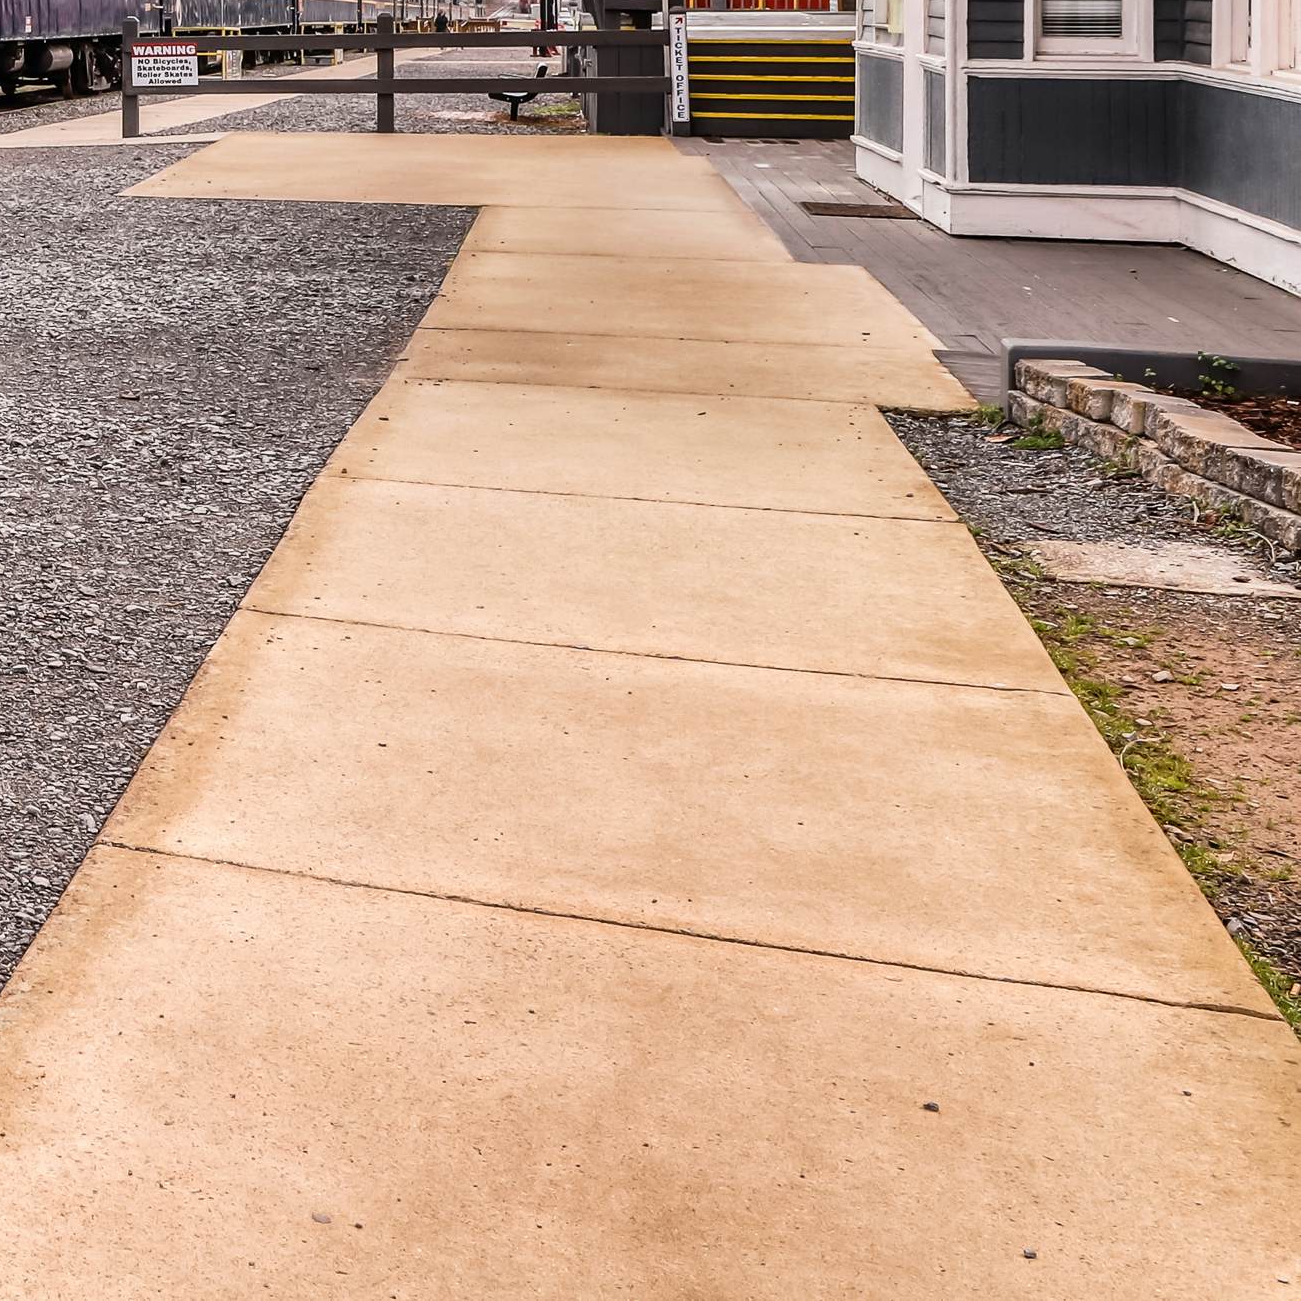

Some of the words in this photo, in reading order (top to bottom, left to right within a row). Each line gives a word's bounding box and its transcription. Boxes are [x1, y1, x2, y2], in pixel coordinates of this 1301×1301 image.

[133, 45, 196, 56] WARNING
[675, 27, 683, 71] TICKET
[153, 58, 192, 66] Bicycles,
[137, 64, 193, 72] Skateboards,
[676, 74, 685, 119] OFFICE
